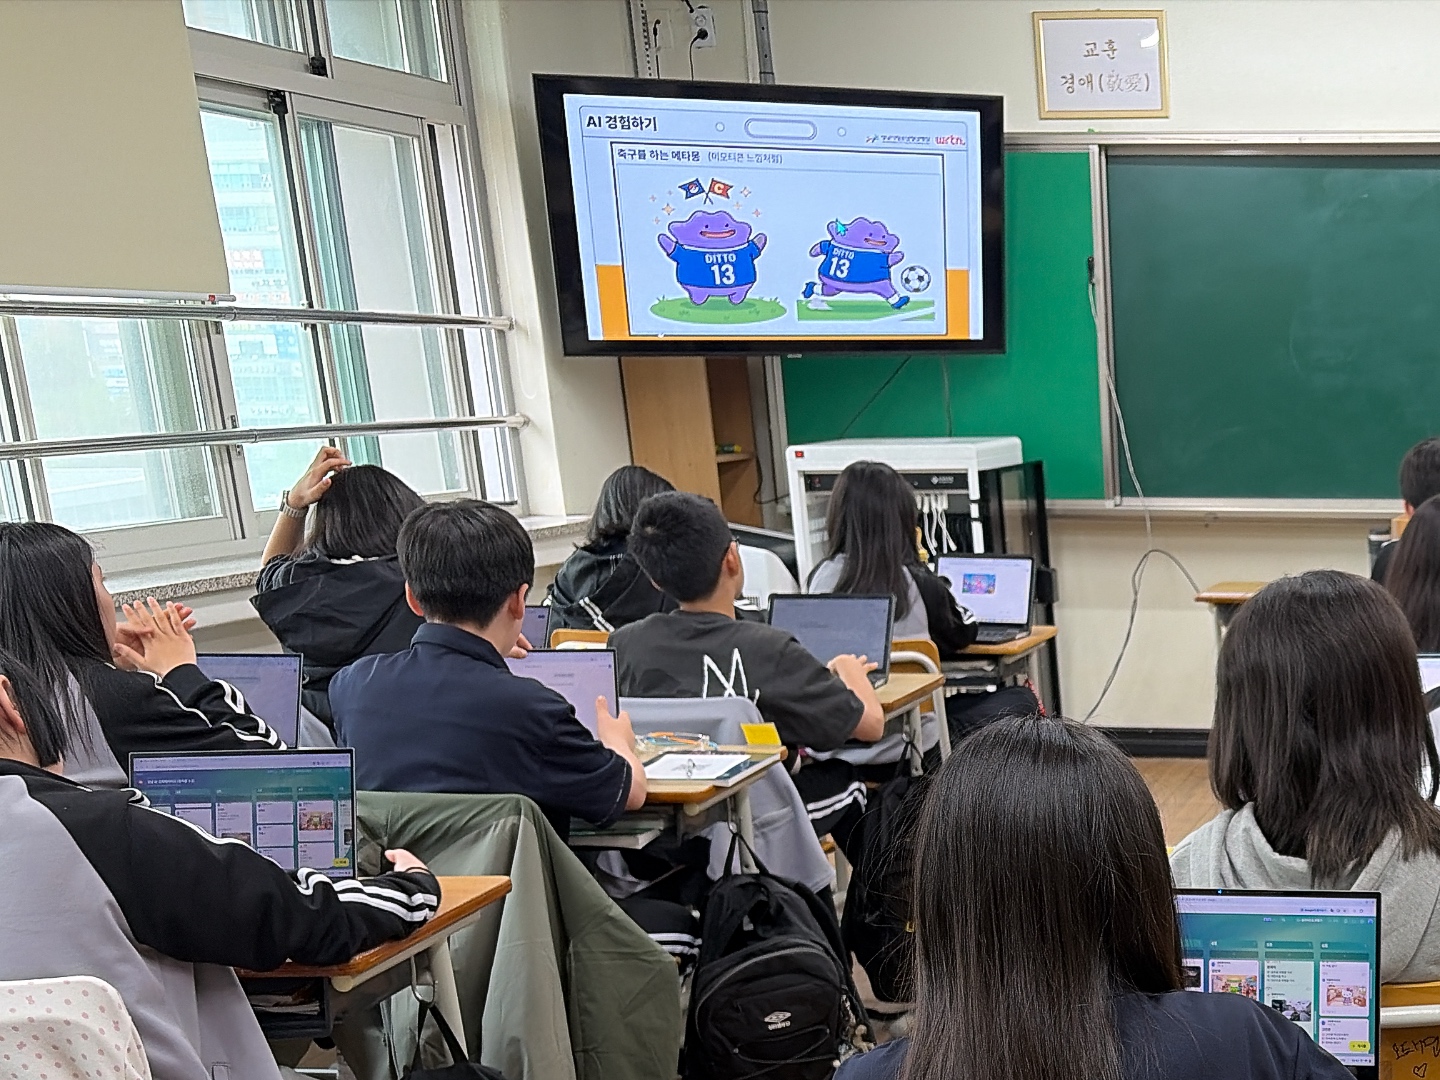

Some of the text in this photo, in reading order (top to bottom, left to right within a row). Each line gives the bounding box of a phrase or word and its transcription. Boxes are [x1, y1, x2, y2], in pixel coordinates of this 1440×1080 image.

[1083, 39, 1117, 59] 교훈
[1061, 72, 1149, 94] 경애(敬愛)
[586, 115, 657, 131] AI 경험하기
[650, 150, 669, 160] 하는
[705, 253, 736, 263] DITTO
[833, 248, 855, 259] DITTO
[711, 264, 735, 285] 13
[829, 257, 850, 278] 13
